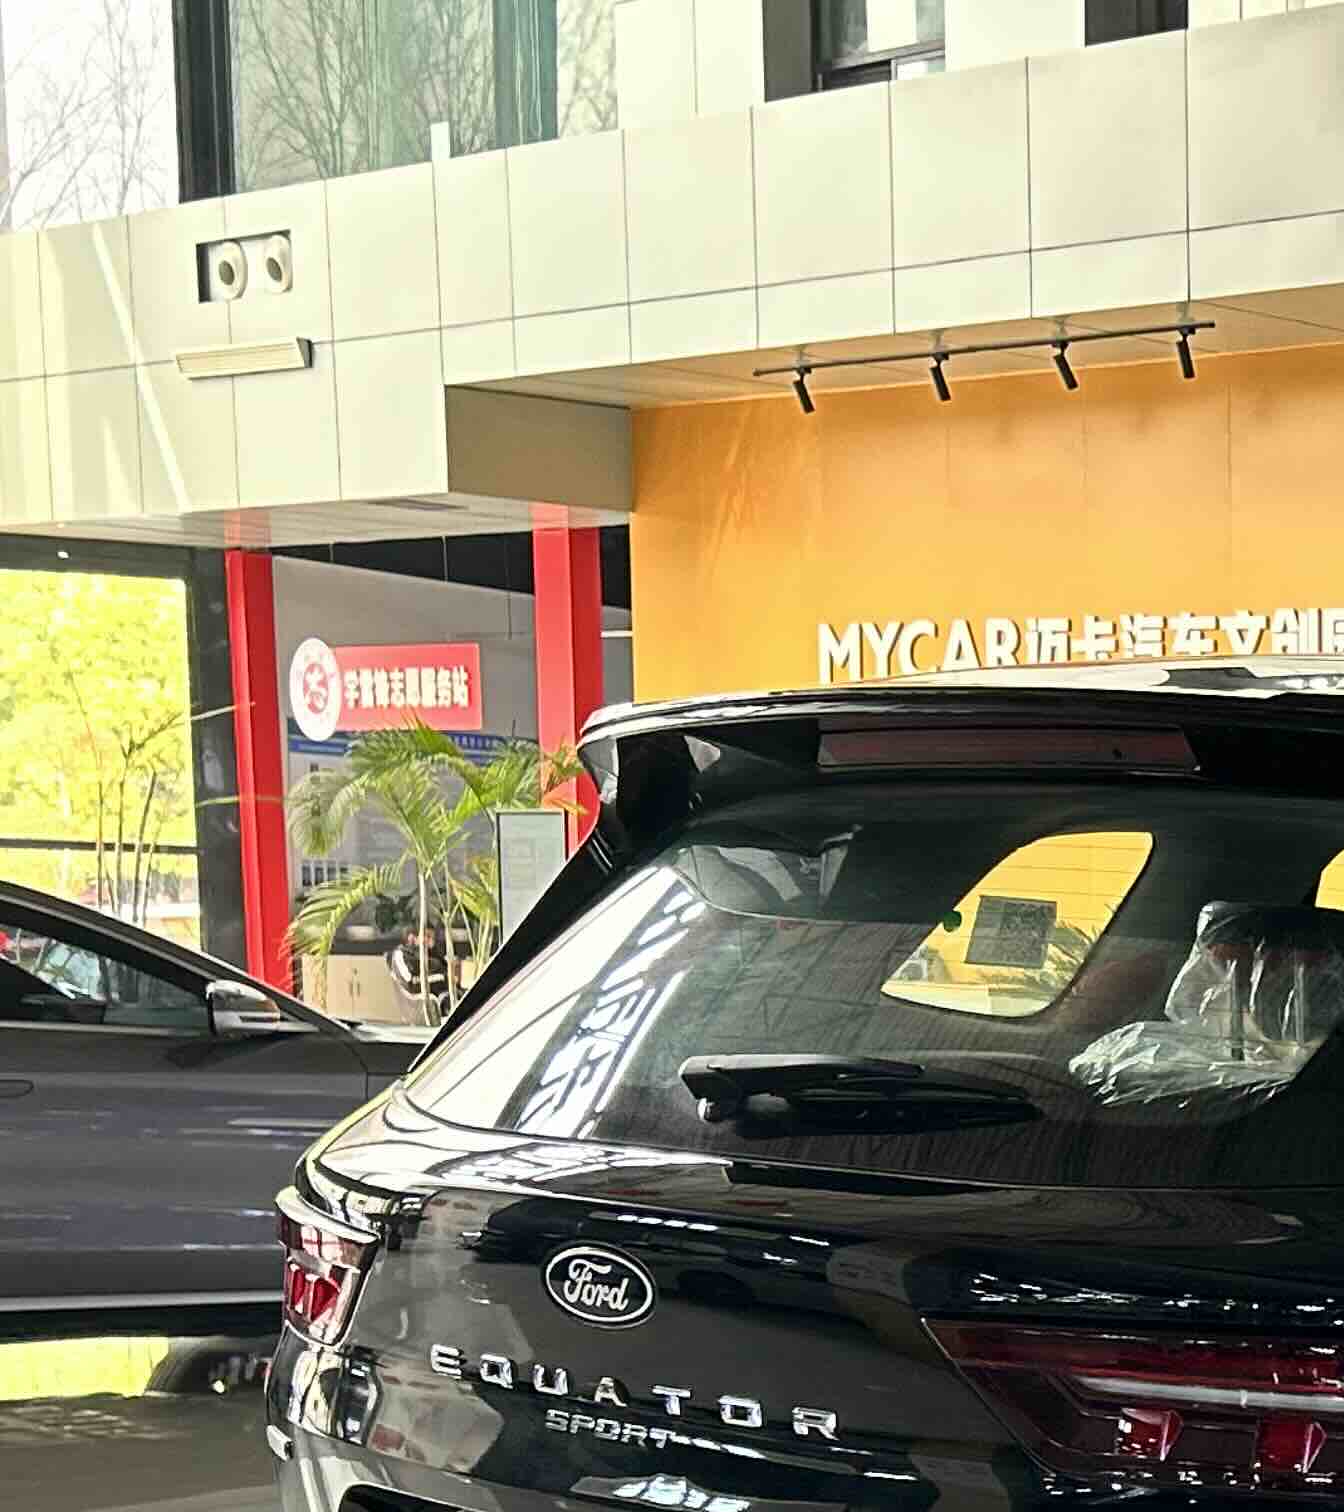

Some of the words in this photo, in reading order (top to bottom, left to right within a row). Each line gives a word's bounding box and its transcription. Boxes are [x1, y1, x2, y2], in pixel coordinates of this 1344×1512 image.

[561, 1256, 632, 1312] Ford
[430, 1346, 838, 1441] EQUATOR
[544, 1407, 672, 1448] SPORT
